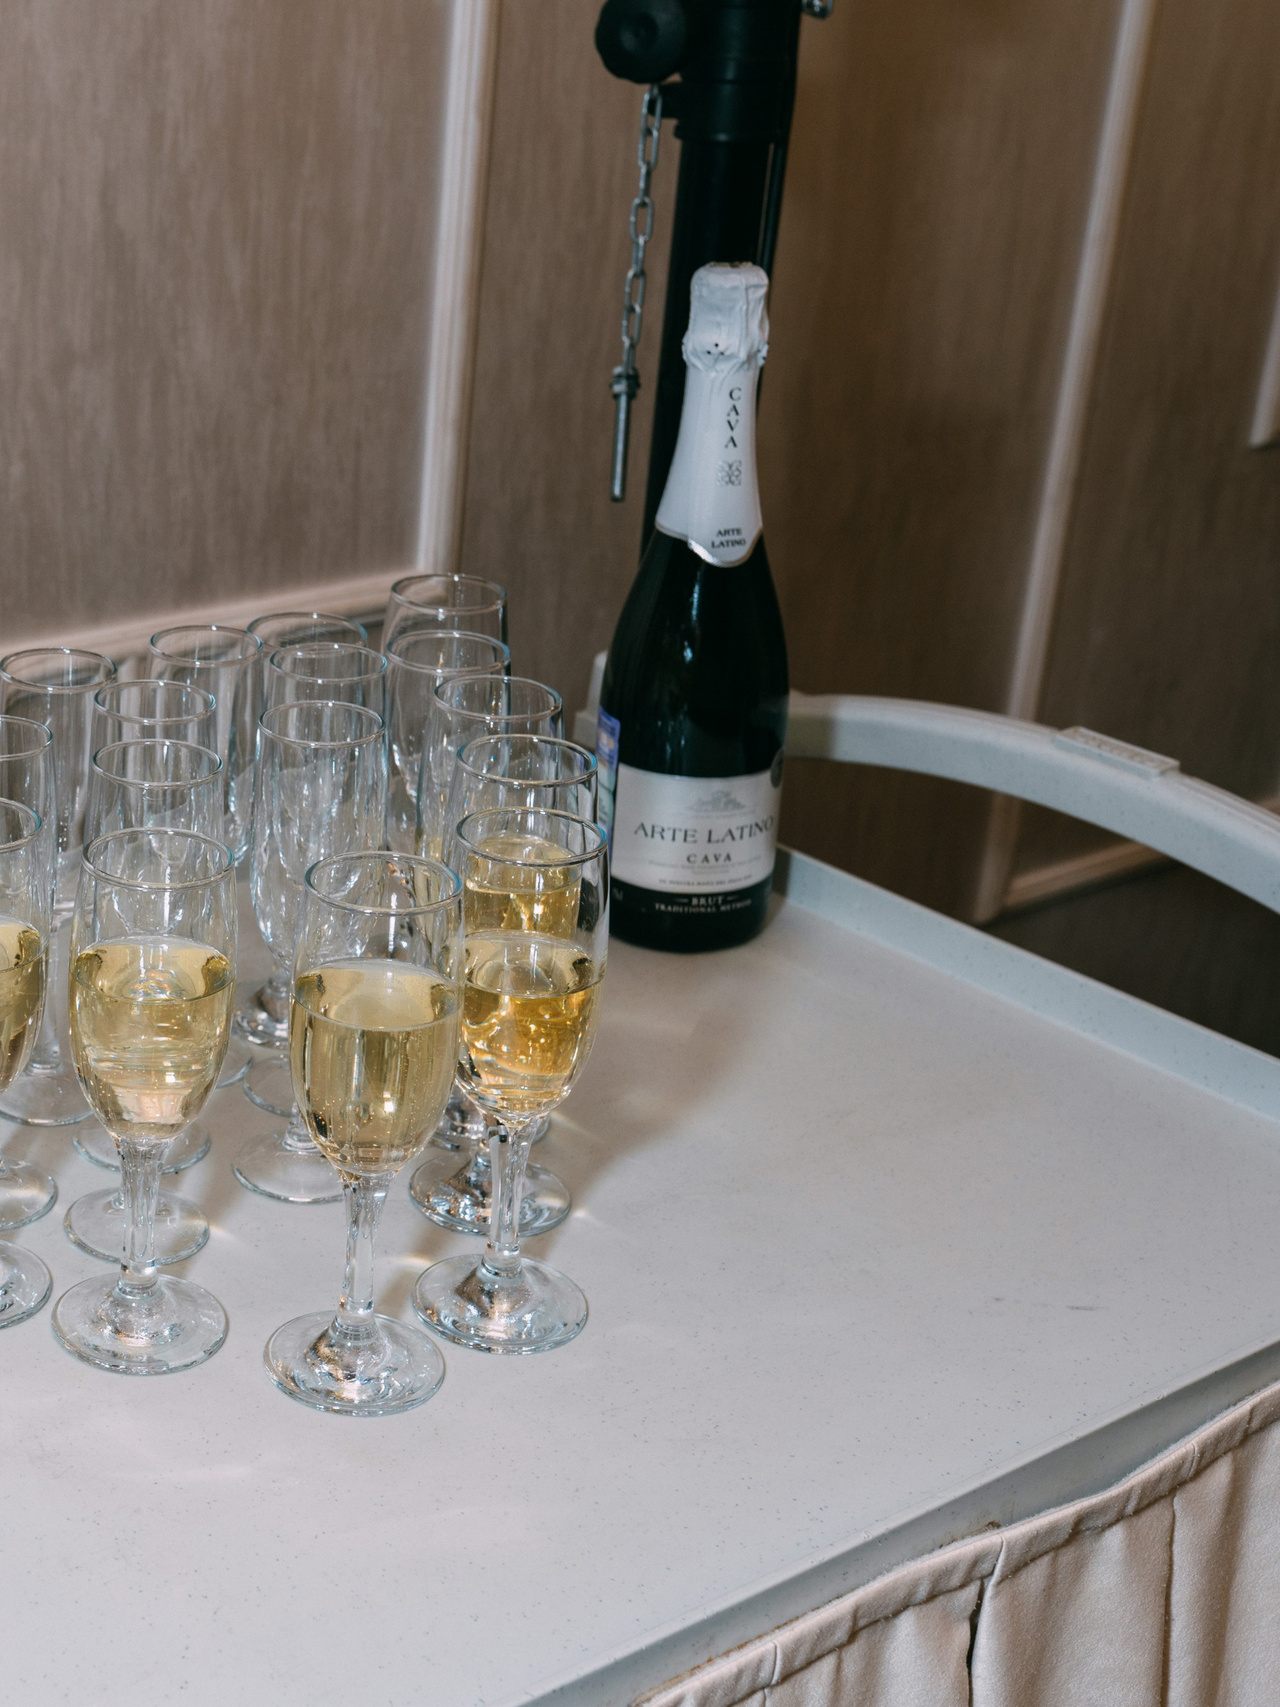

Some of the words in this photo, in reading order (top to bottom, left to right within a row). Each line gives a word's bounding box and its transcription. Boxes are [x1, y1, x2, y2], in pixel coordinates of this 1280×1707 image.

[725, 388, 742, 448] CAVA
[717, 529, 742, 537] ARTE
[712, 538, 746, 548] LATINO
[634, 822, 698, 844] ARTE
[708, 816, 773, 843] LATINO
[687, 853, 732, 864] CAVA
